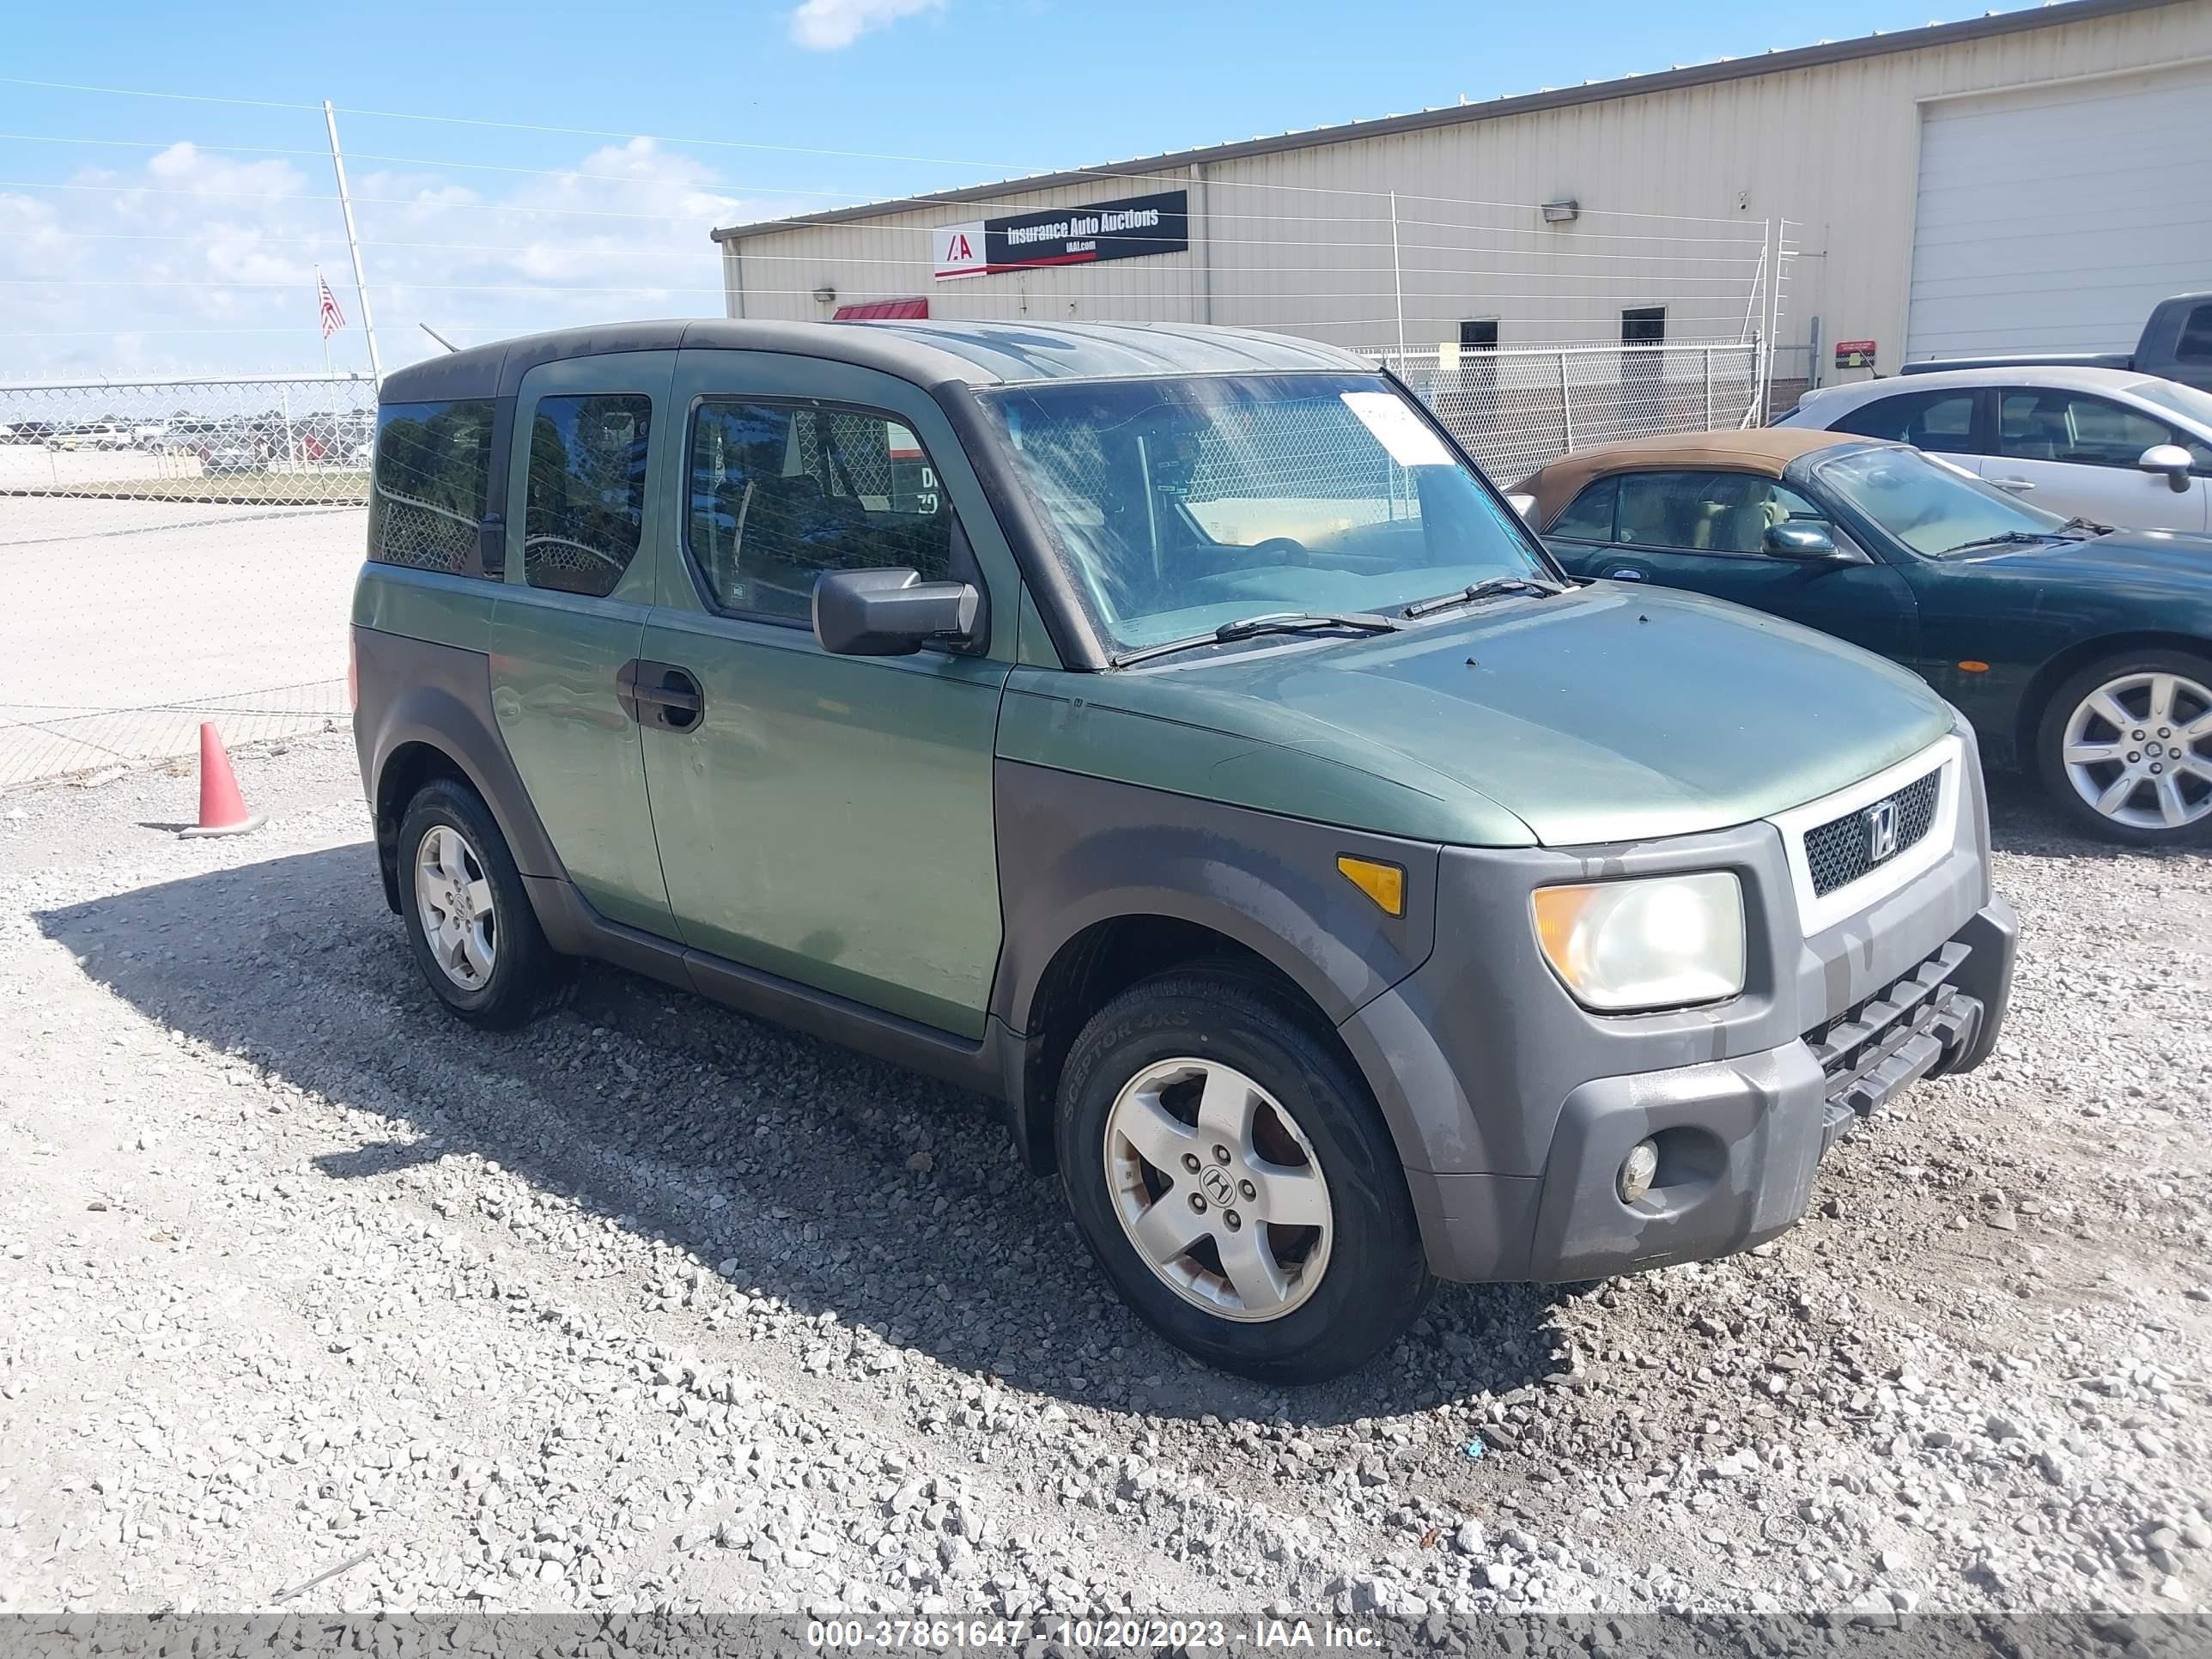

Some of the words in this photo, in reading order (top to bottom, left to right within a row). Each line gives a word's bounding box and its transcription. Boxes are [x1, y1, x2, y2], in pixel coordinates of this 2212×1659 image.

[1007, 222, 1068, 246] Insurance
[1070, 216, 1099, 236] Auto
[1100, 209, 1158, 233] Auctions
[1064, 1023, 1132, 1121] SCEPTOR
